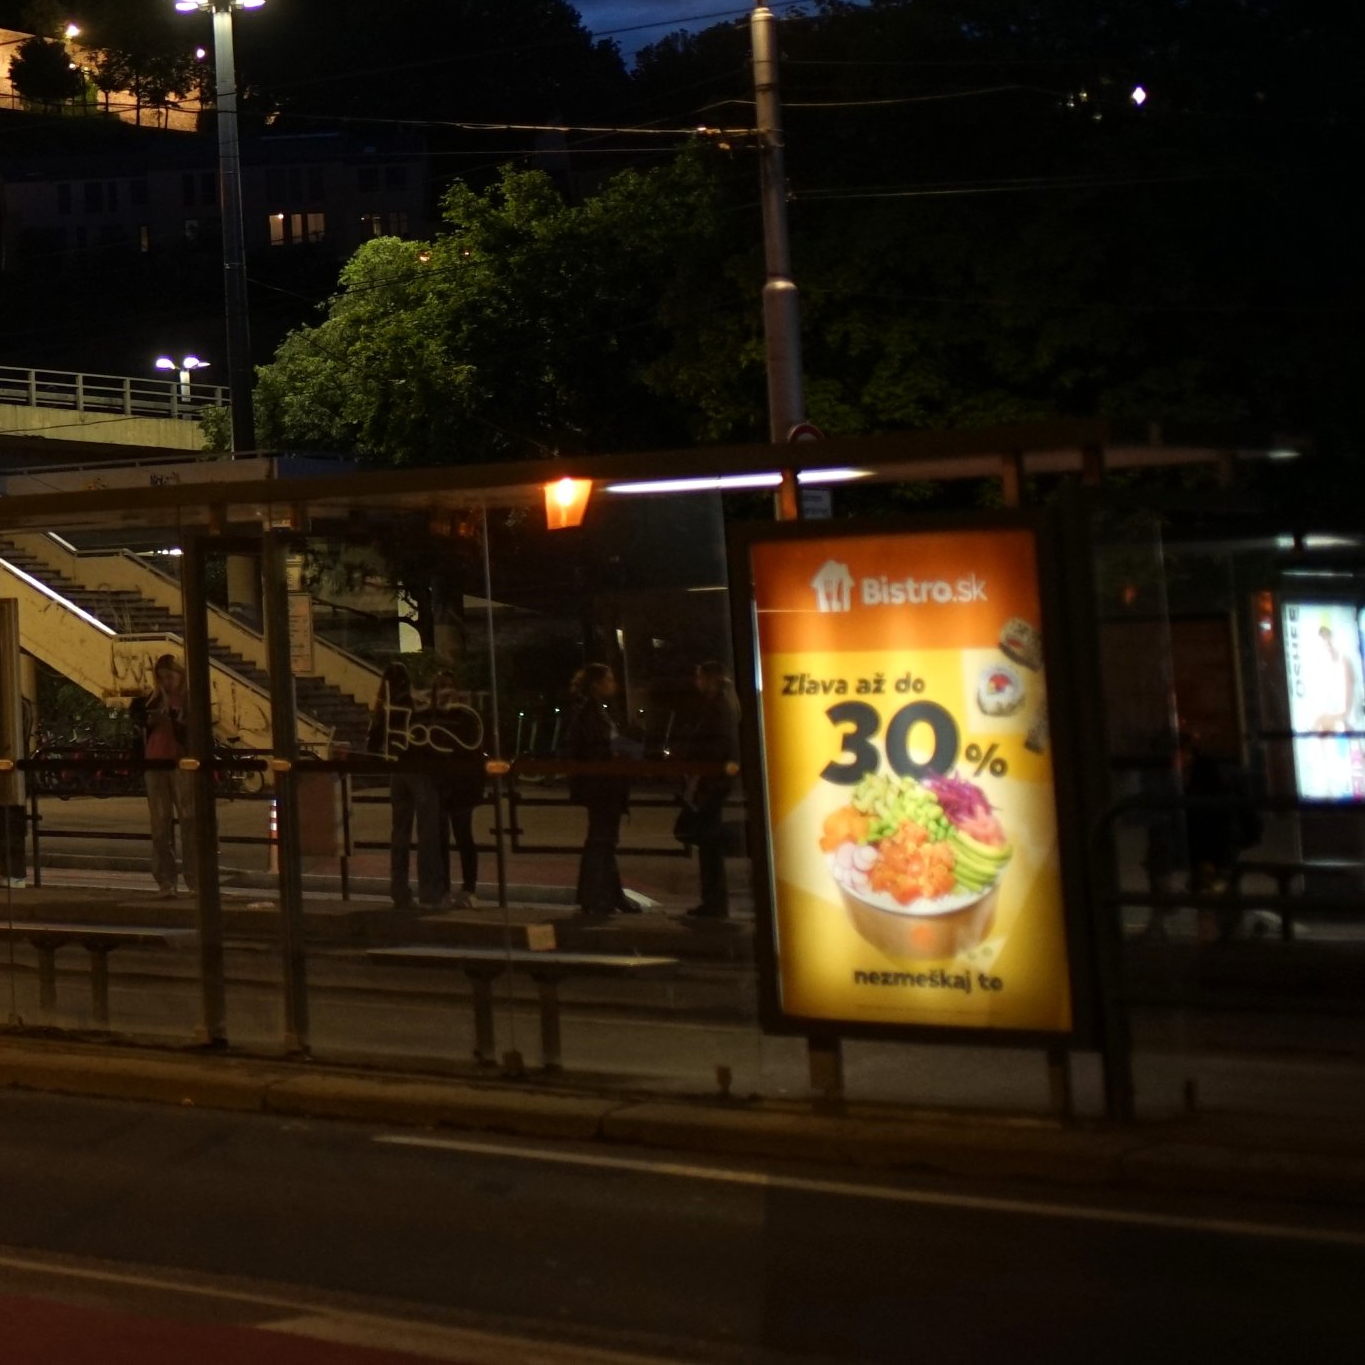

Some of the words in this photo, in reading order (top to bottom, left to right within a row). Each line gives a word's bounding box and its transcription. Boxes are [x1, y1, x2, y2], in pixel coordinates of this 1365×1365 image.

[861, 572, 988, 605] Bistro.sk
[781, 672, 849, 696] Zľava
[855, 673, 886, 695] až
[894, 672, 926, 694] do
[853, 969, 971, 994] nezmeškaj
[978, 973, 1004, 991] to
